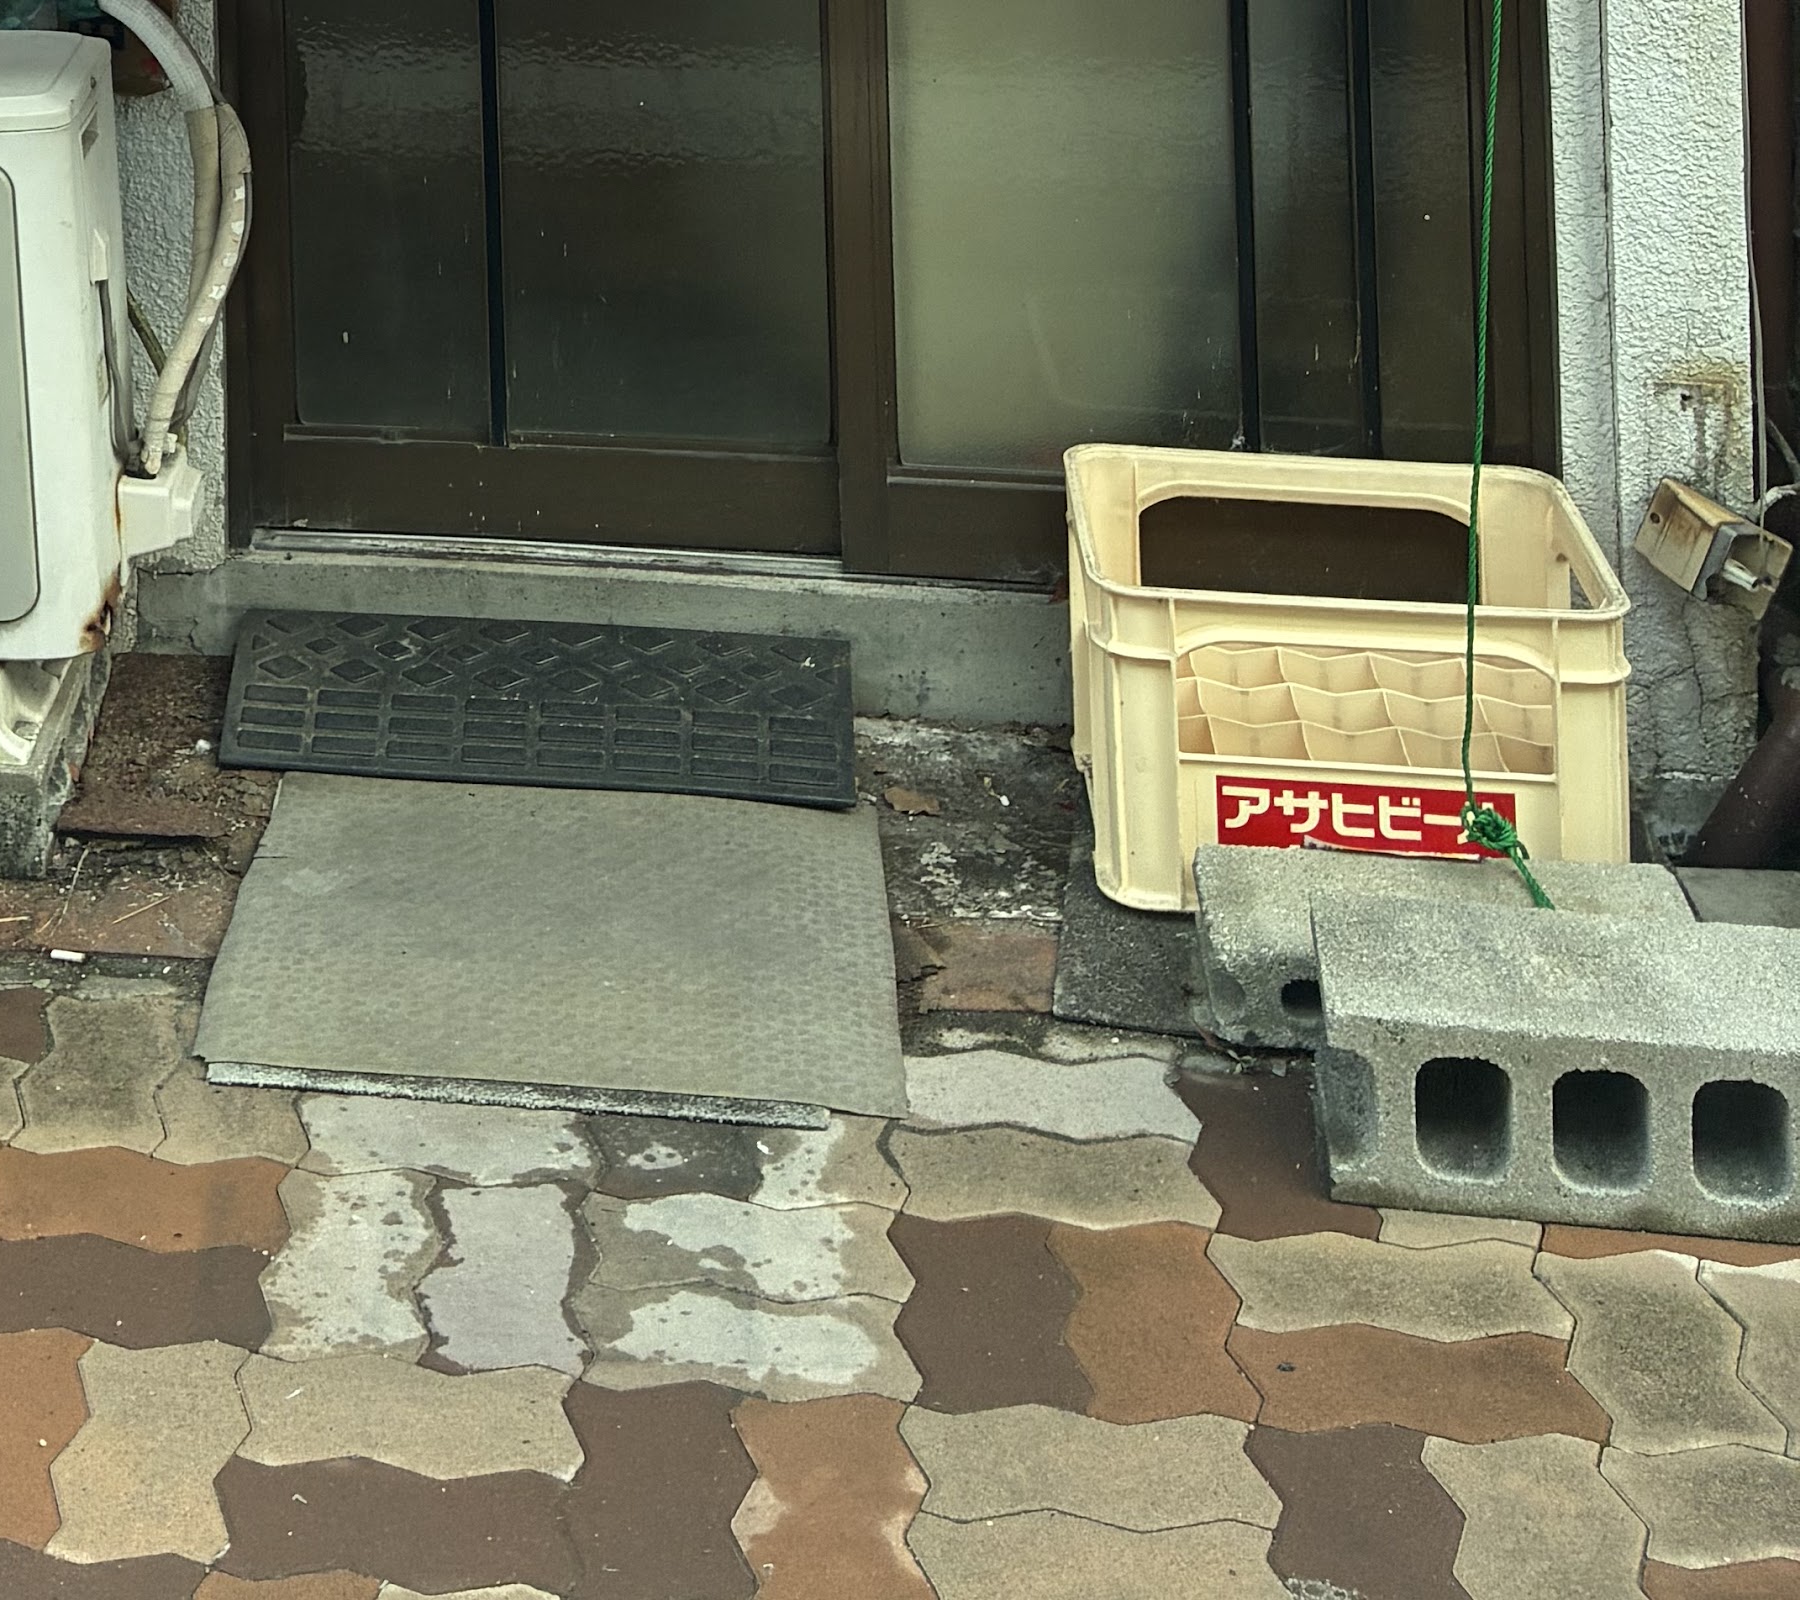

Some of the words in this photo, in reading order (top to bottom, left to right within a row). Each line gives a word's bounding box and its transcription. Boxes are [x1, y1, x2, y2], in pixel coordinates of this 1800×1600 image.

[1221, 785, 1508, 846] アサヒビー
